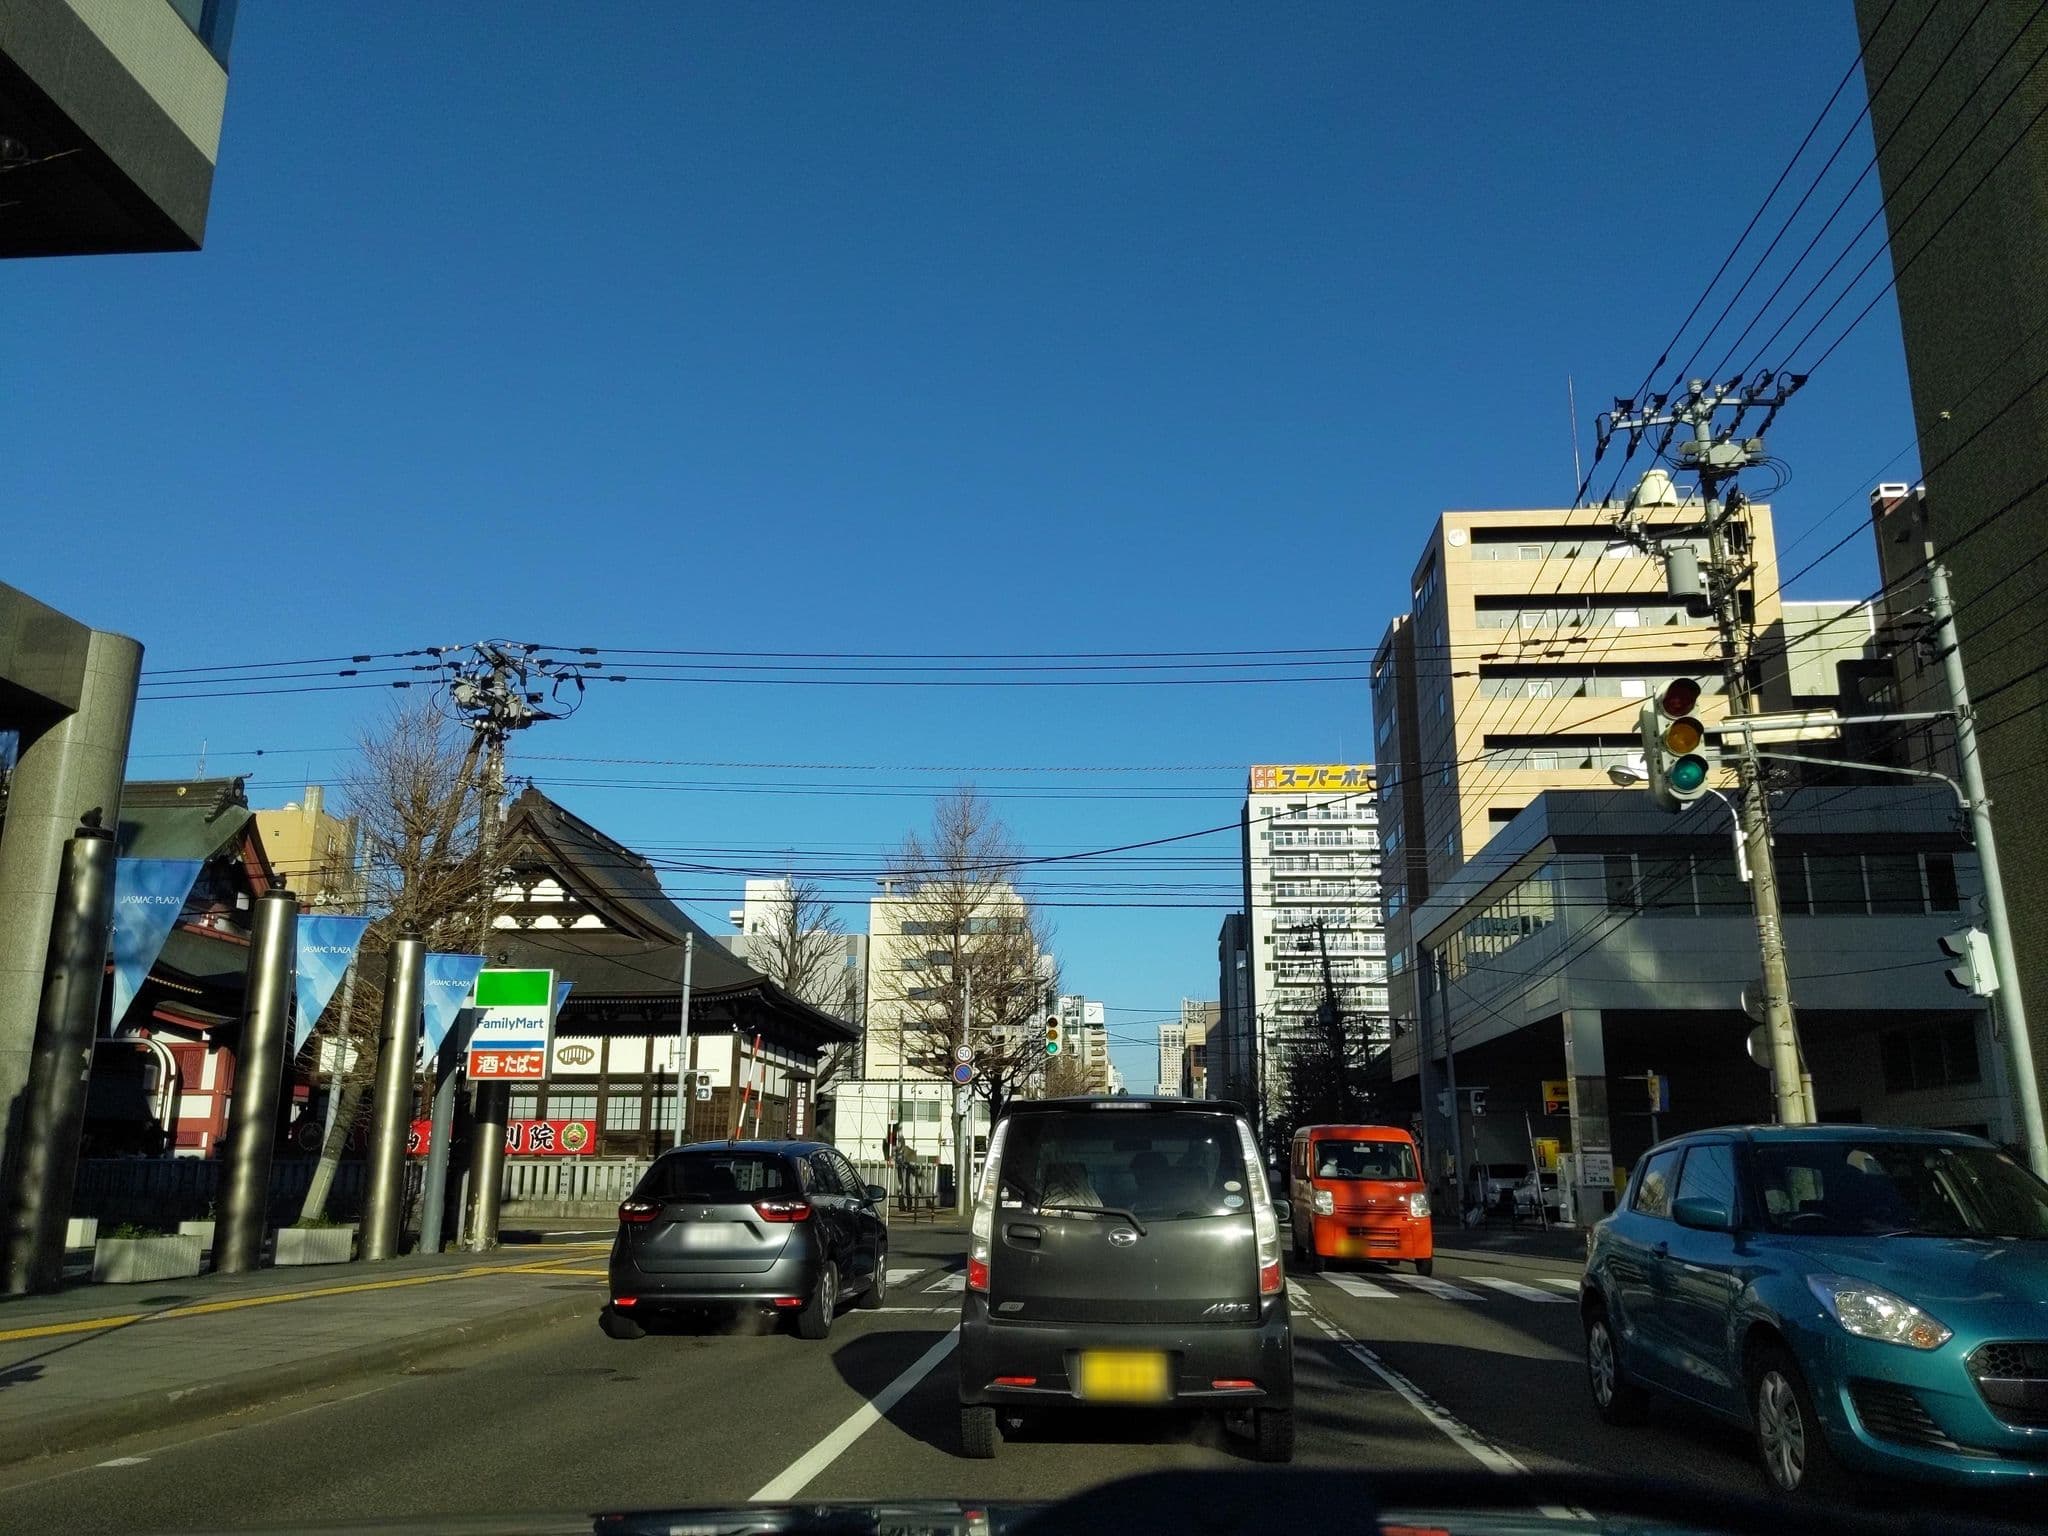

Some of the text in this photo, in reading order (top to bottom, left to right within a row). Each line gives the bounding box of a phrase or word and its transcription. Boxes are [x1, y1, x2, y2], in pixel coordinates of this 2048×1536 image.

[120, 895, 180, 905] JASMAC PLAZA
[303, 945, 352, 954] JASMAC PLAZA
[452, 979, 471, 987] PLAZA
[476, 1017, 545, 1031] FamilyMart
[959, 1049, 970, 1058] 50
[477, 1055, 541, 1073] 酒・たばこ
[1201, 1302, 1251, 1315] MOVE
